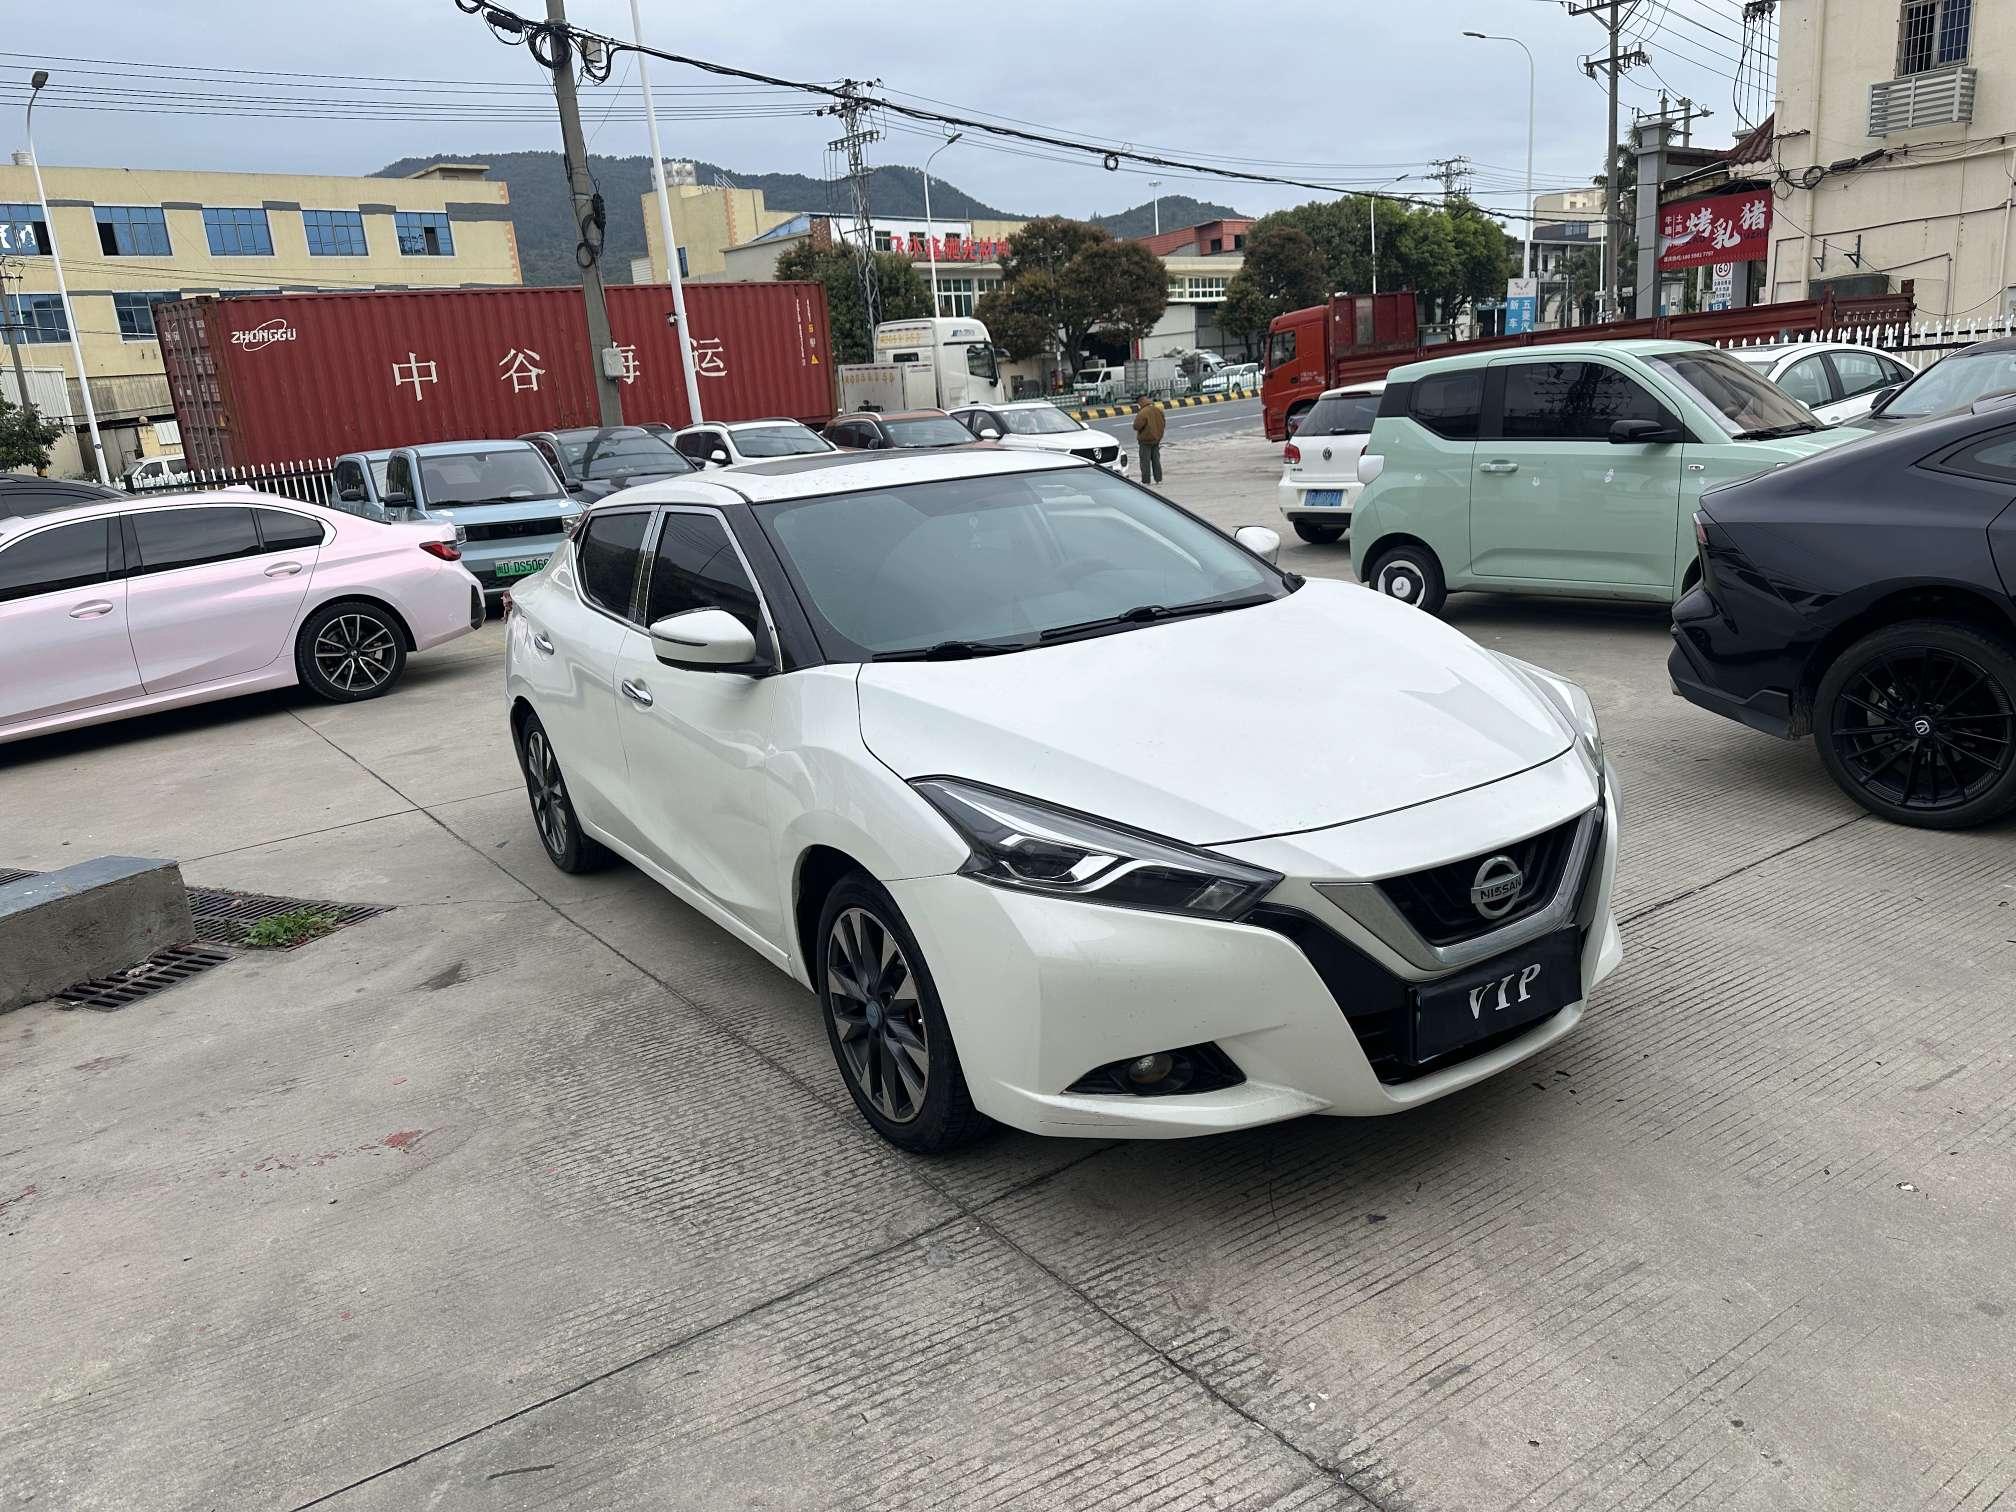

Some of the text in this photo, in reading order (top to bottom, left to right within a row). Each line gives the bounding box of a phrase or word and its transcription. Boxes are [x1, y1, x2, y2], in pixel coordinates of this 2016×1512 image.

[1686, 200, 1767, 250] 烤乳猪
[1718, 263, 1729, 273] 60
[231, 328, 297, 344] ZHONGGU
[1479, 876, 1522, 901] NISSAN
[1469, 963, 1541, 1020] VIP
